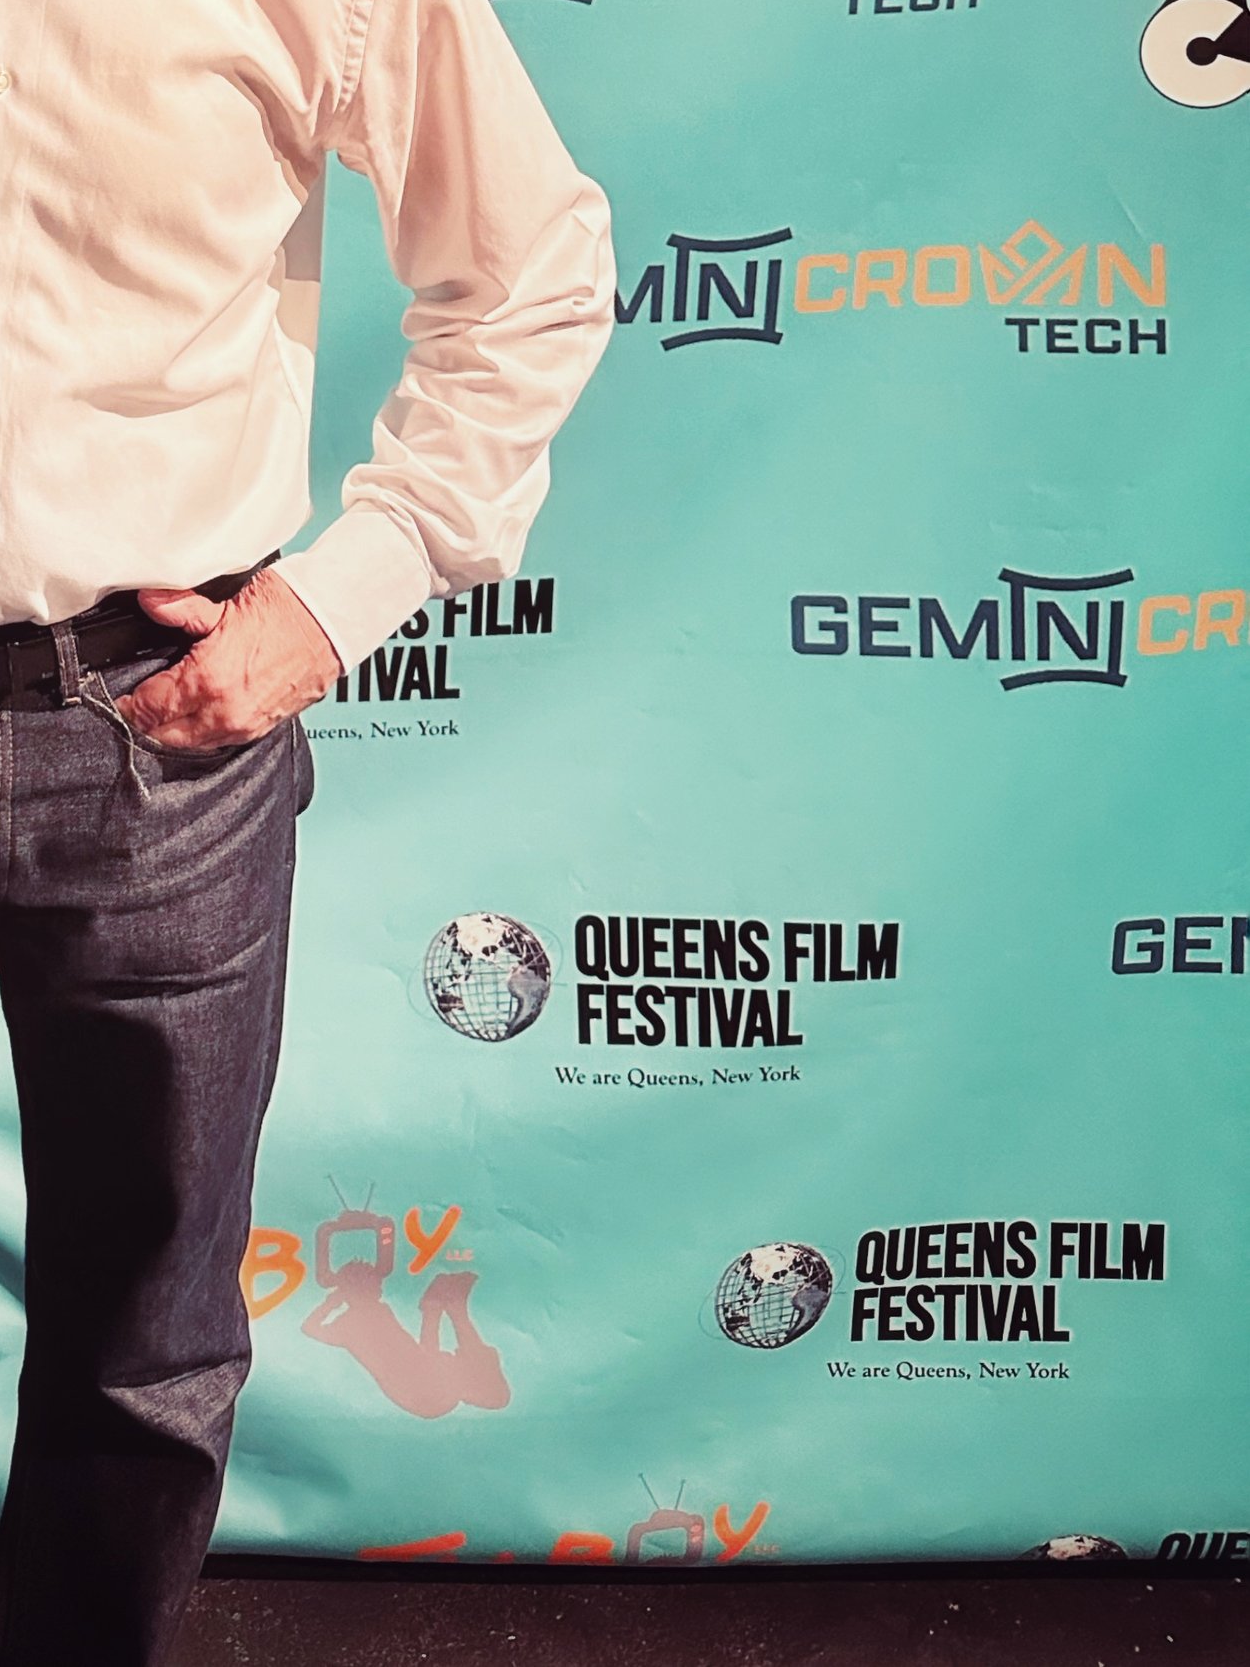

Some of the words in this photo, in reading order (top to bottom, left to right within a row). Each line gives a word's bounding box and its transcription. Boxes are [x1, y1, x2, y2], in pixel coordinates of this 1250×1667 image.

[614, 226, 792, 352] MINI
[794, 219, 1166, 314] CROWN
[1004, 317, 1167, 354] TECH
[441, 577, 555, 638] FILM
[790, 567, 1135, 692] GEMINI
[306, 724, 362, 741] ueens,
[370, 722, 411, 738] New
[418, 720, 459, 736] York
[574, 914, 770, 981] QUEENS
[784, 922, 899, 982] FILM
[577, 984, 803, 1047] FESTIVAL
[555, 1066, 586, 1085] We
[593, 1072, 621, 1085] are
[628, 1068, 704, 1088] Queens,
[712, 1069, 753, 1085] New
[759, 1066, 801, 1082] York
[855, 1221, 1037, 1284] QUEENS
[1050, 1222, 1165, 1280] FILM
[851, 1285, 1070, 1342] FESTIVAL
[826, 1362, 856, 1379] We
[862, 1367, 891, 1379] are
[896, 1362, 971, 1381] Queens,
[979, 1362, 1020, 1379] New
[1025, 1362, 1069, 1379] York
